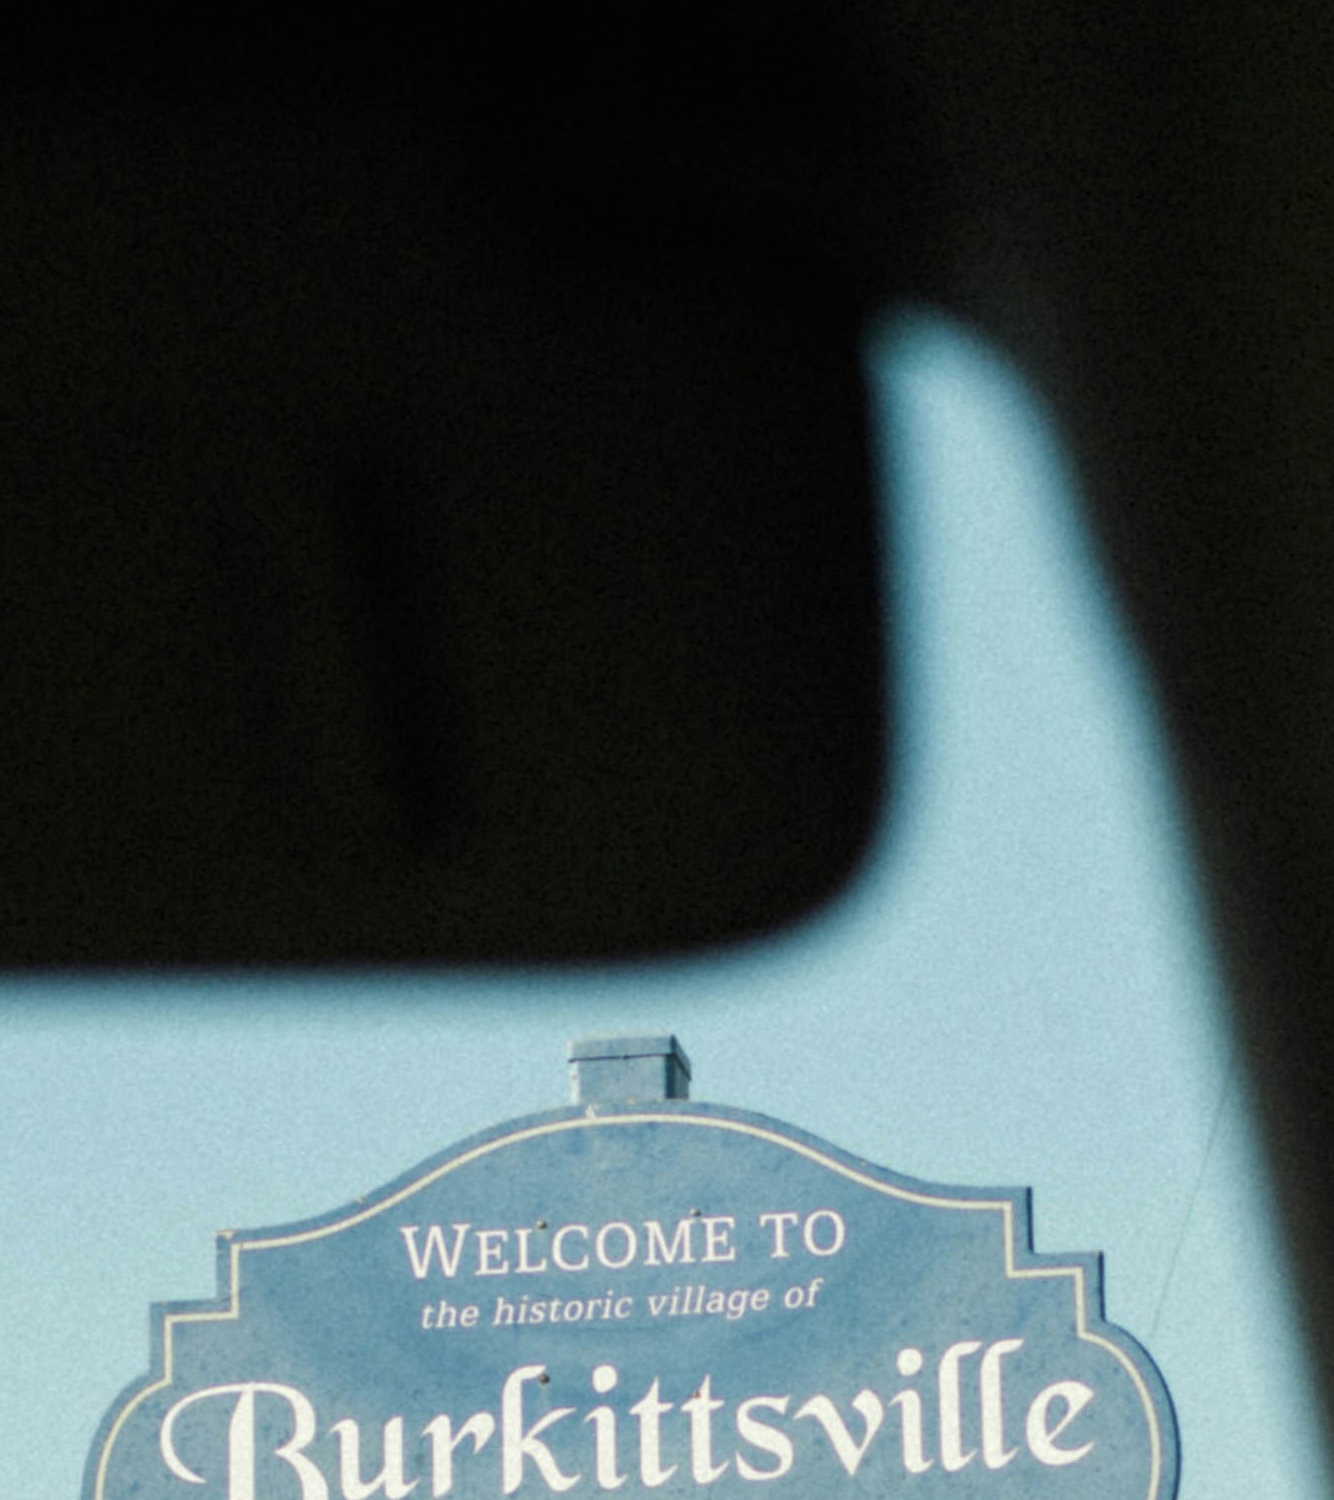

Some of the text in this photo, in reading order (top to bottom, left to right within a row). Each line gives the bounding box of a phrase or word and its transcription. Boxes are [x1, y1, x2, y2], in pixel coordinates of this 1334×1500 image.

[399, 1209, 847, 1279] WELCOME TO
[420, 1277, 825, 1329] the historic village of
